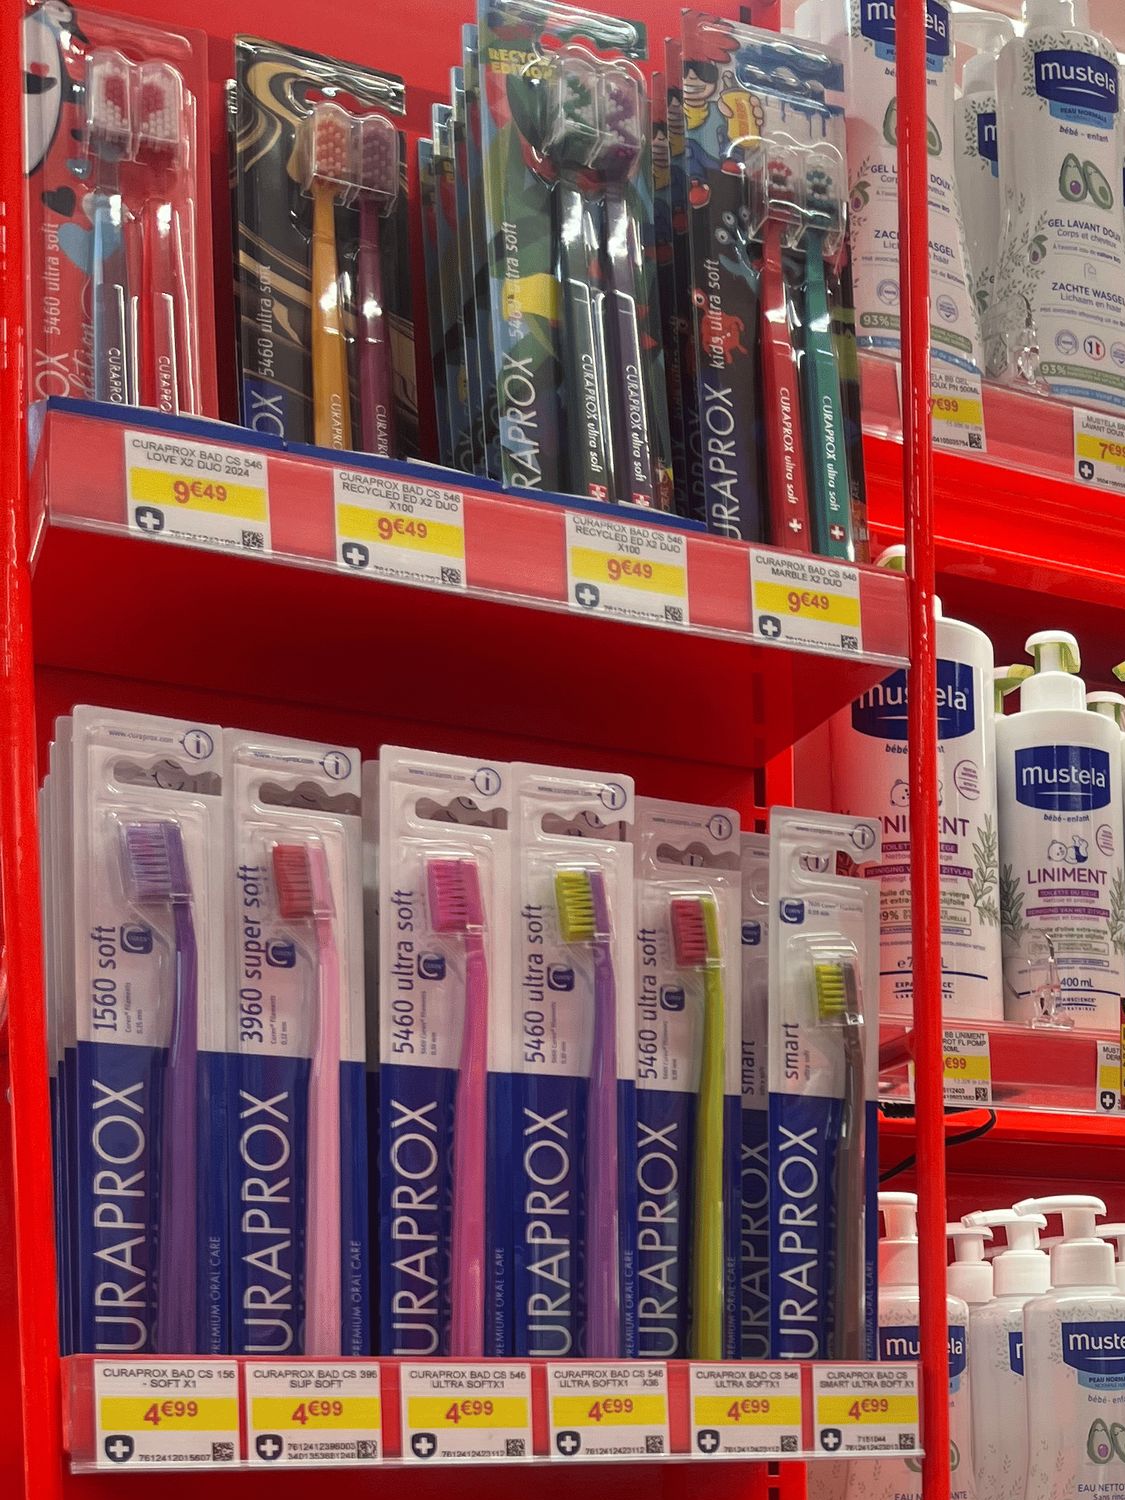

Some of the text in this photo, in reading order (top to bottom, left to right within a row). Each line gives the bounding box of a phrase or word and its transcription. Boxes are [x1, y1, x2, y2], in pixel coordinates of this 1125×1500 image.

[1041, 61, 1117, 95] mustela
[259, 265, 275, 377] 5460 ultra soft
[706, 259, 726, 370] kids ultra soft
[133, 439, 263, 469] CURAPROX BAD CS 546
[147, 451, 250, 477] LOVE X2 DUO 2024
[173, 479, 227, 504] 9€49
[377, 516, 428, 539] 9€49
[607, 558, 653, 579] 9€49
[787, 592, 829, 612] 9€49
[1022, 764, 1105, 789] mustela
[1027, 869, 1108, 885] LINIMENT
[237, 864, 269, 1043] 3960 super soft
[91, 925, 118, 1032] 1560 soft
[391, 890, 415, 1054] 5460 ultra soft
[1061, 977, 1093, 988] 400 mL
[784, 1022, 799, 1080] smart
[92, 1079, 148, 1351] URAPROX
[778, 1125, 819, 1360] URAPROX
[103, 1368, 235, 1379] CURAPROX BAD CS 156
[150, 1379, 197, 1389] SOFT X1
[143, 1401, 198, 1425] 4€99
[291, 1401, 343, 1425] 4€99
[588, 1399, 633, 1422] 4€99
[848, 1399, 888, 1421] 4€99
[1077, 1483, 1096, 1493] EAU
